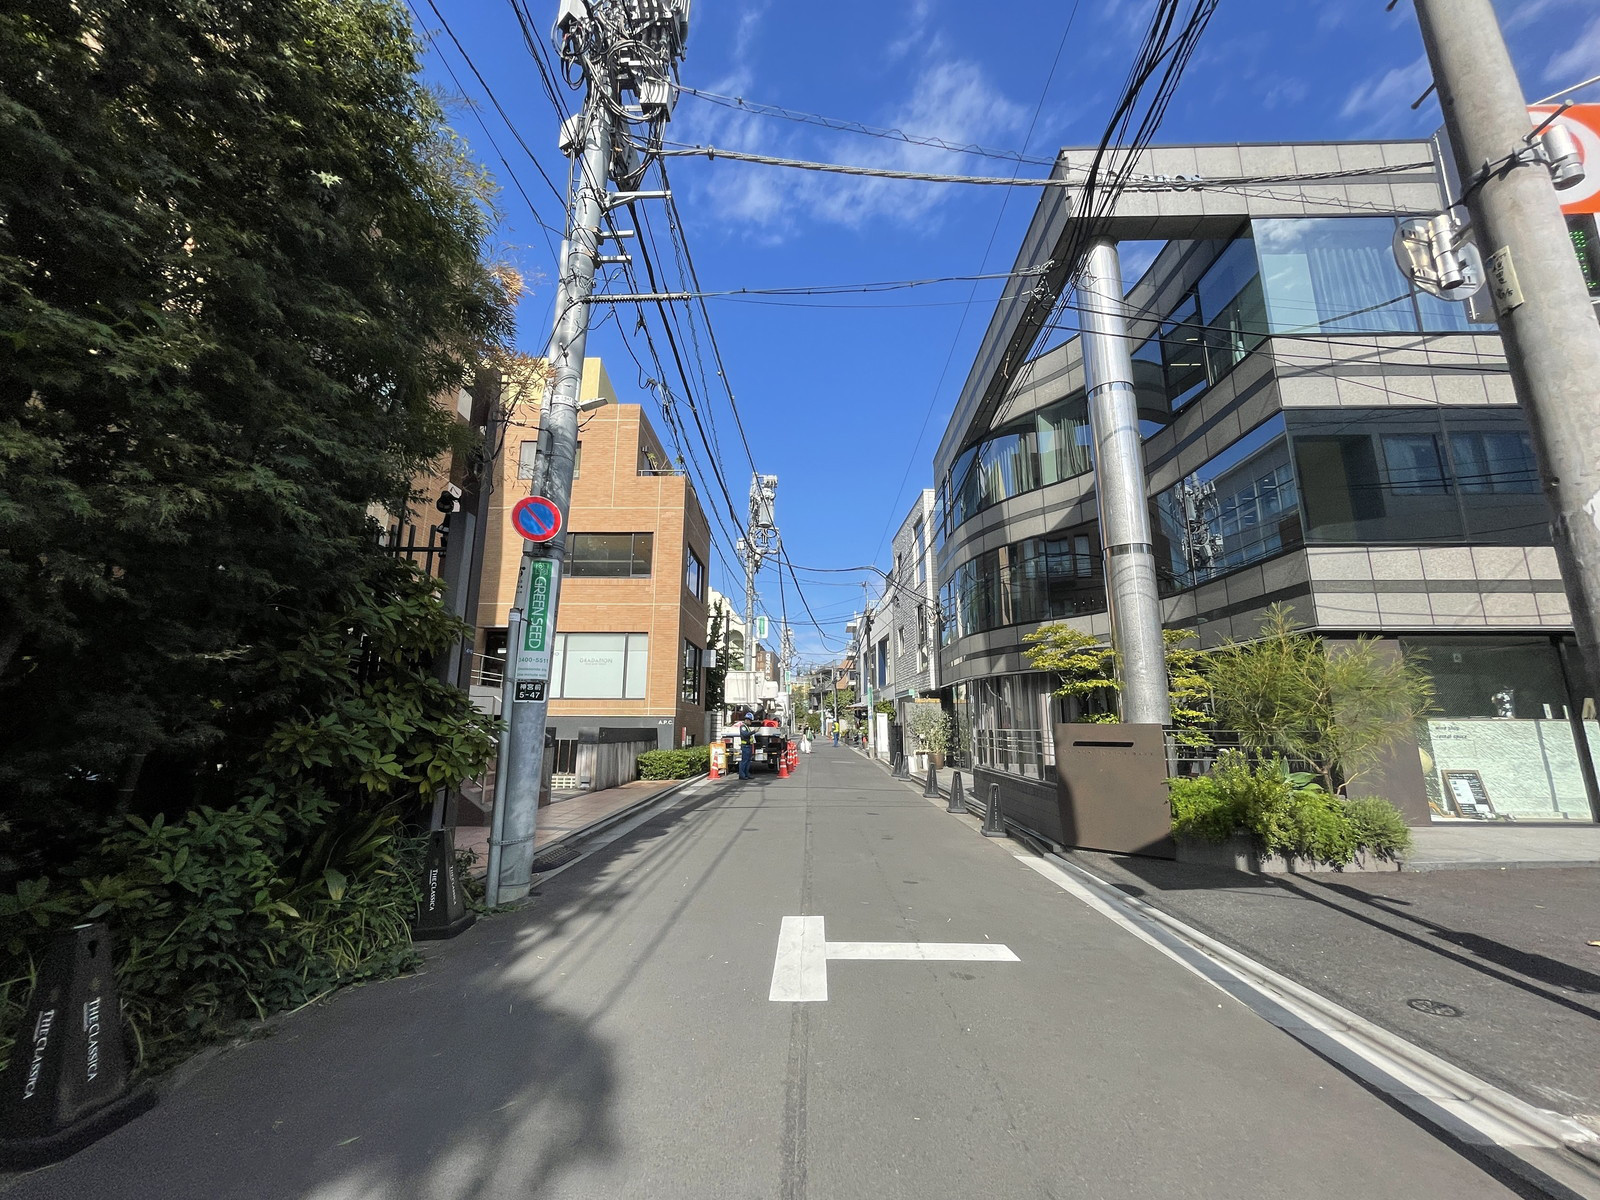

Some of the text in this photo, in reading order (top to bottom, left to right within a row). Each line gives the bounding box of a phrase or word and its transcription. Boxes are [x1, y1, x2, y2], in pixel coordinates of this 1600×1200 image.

[531, 576, 547, 616] GREEN
[528, 617, 544, 649] SEED
[519, 691, 541, 699] 5-47
[520, 683, 542, 691] 神宮前
